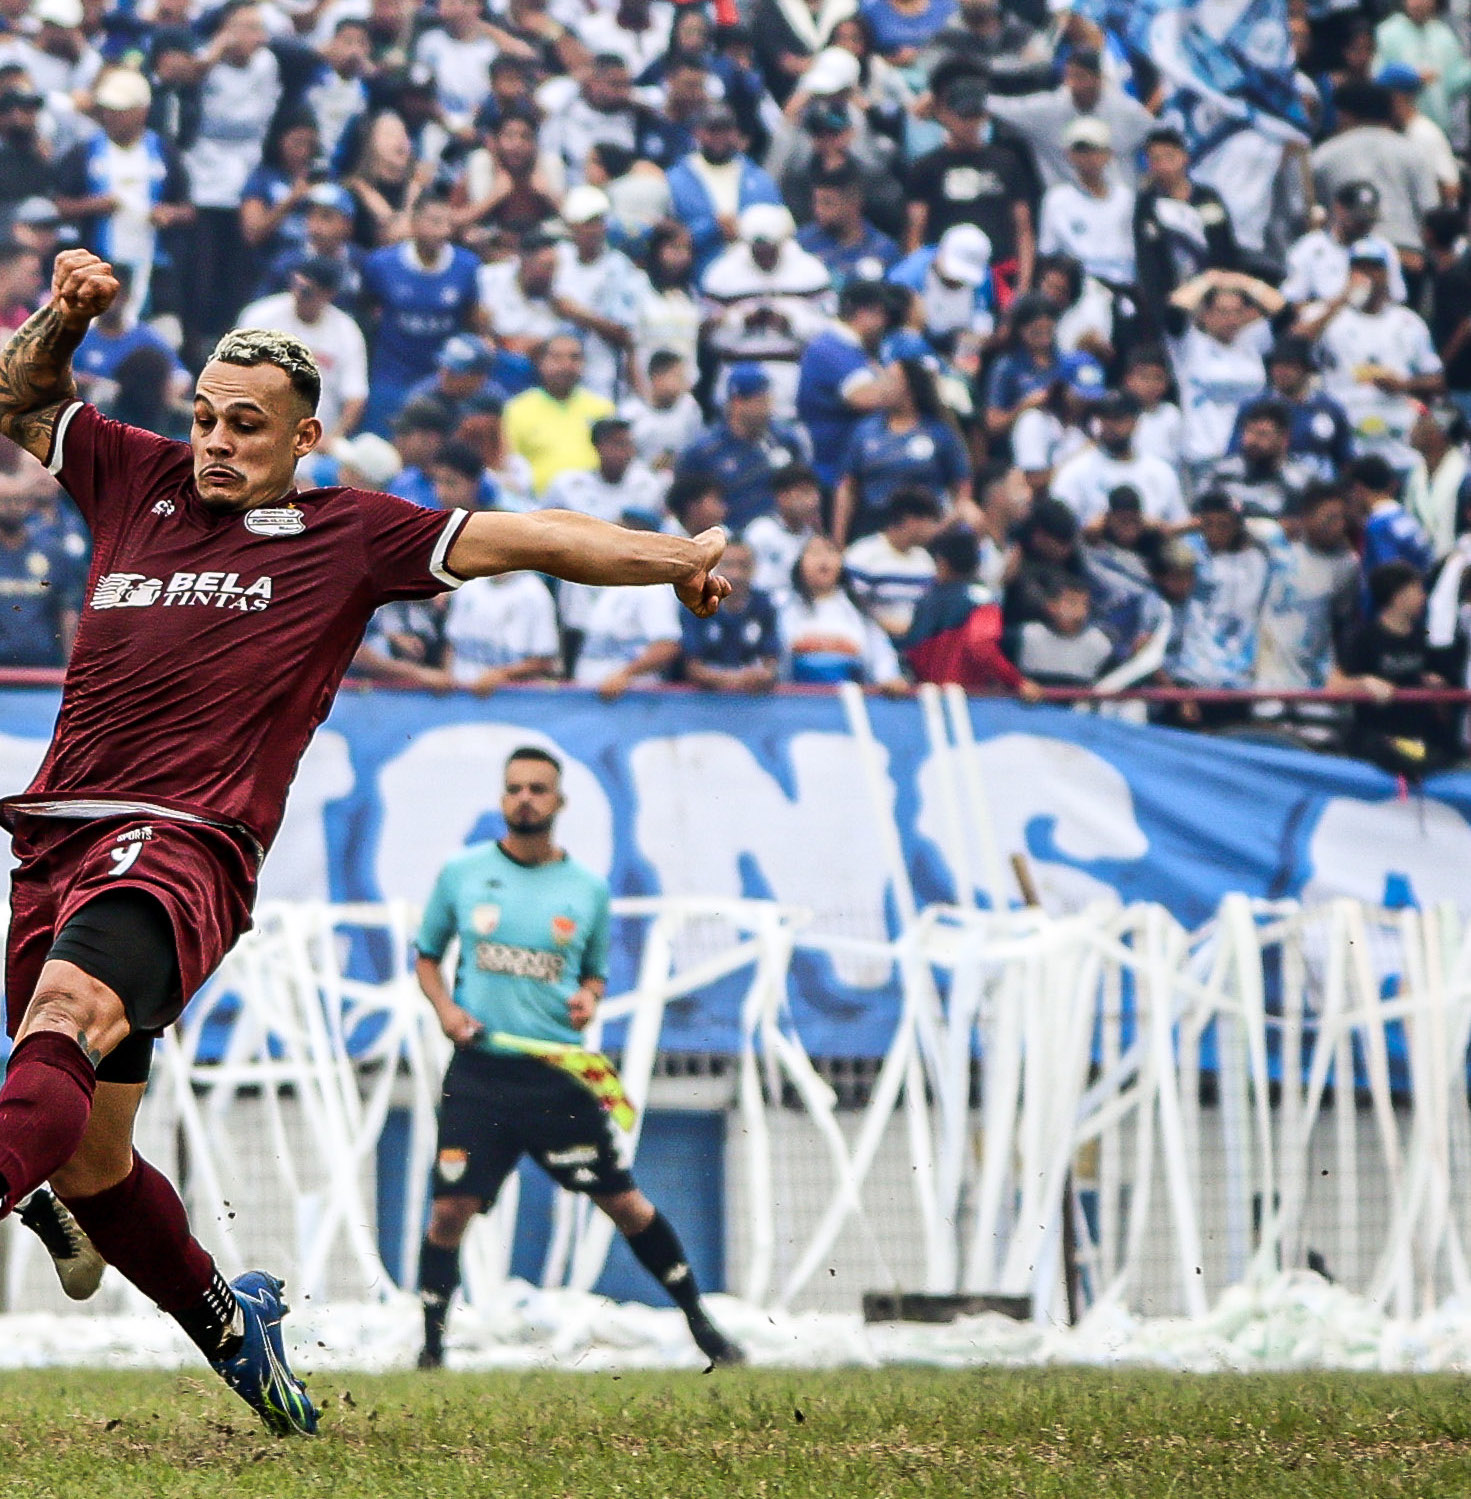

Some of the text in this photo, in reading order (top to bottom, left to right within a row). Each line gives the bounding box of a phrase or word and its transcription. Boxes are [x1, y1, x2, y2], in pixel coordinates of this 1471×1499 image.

[167, 572, 272, 599] BELA
[163, 592, 270, 612] TINTAS
[108, 841, 143, 876] 9
